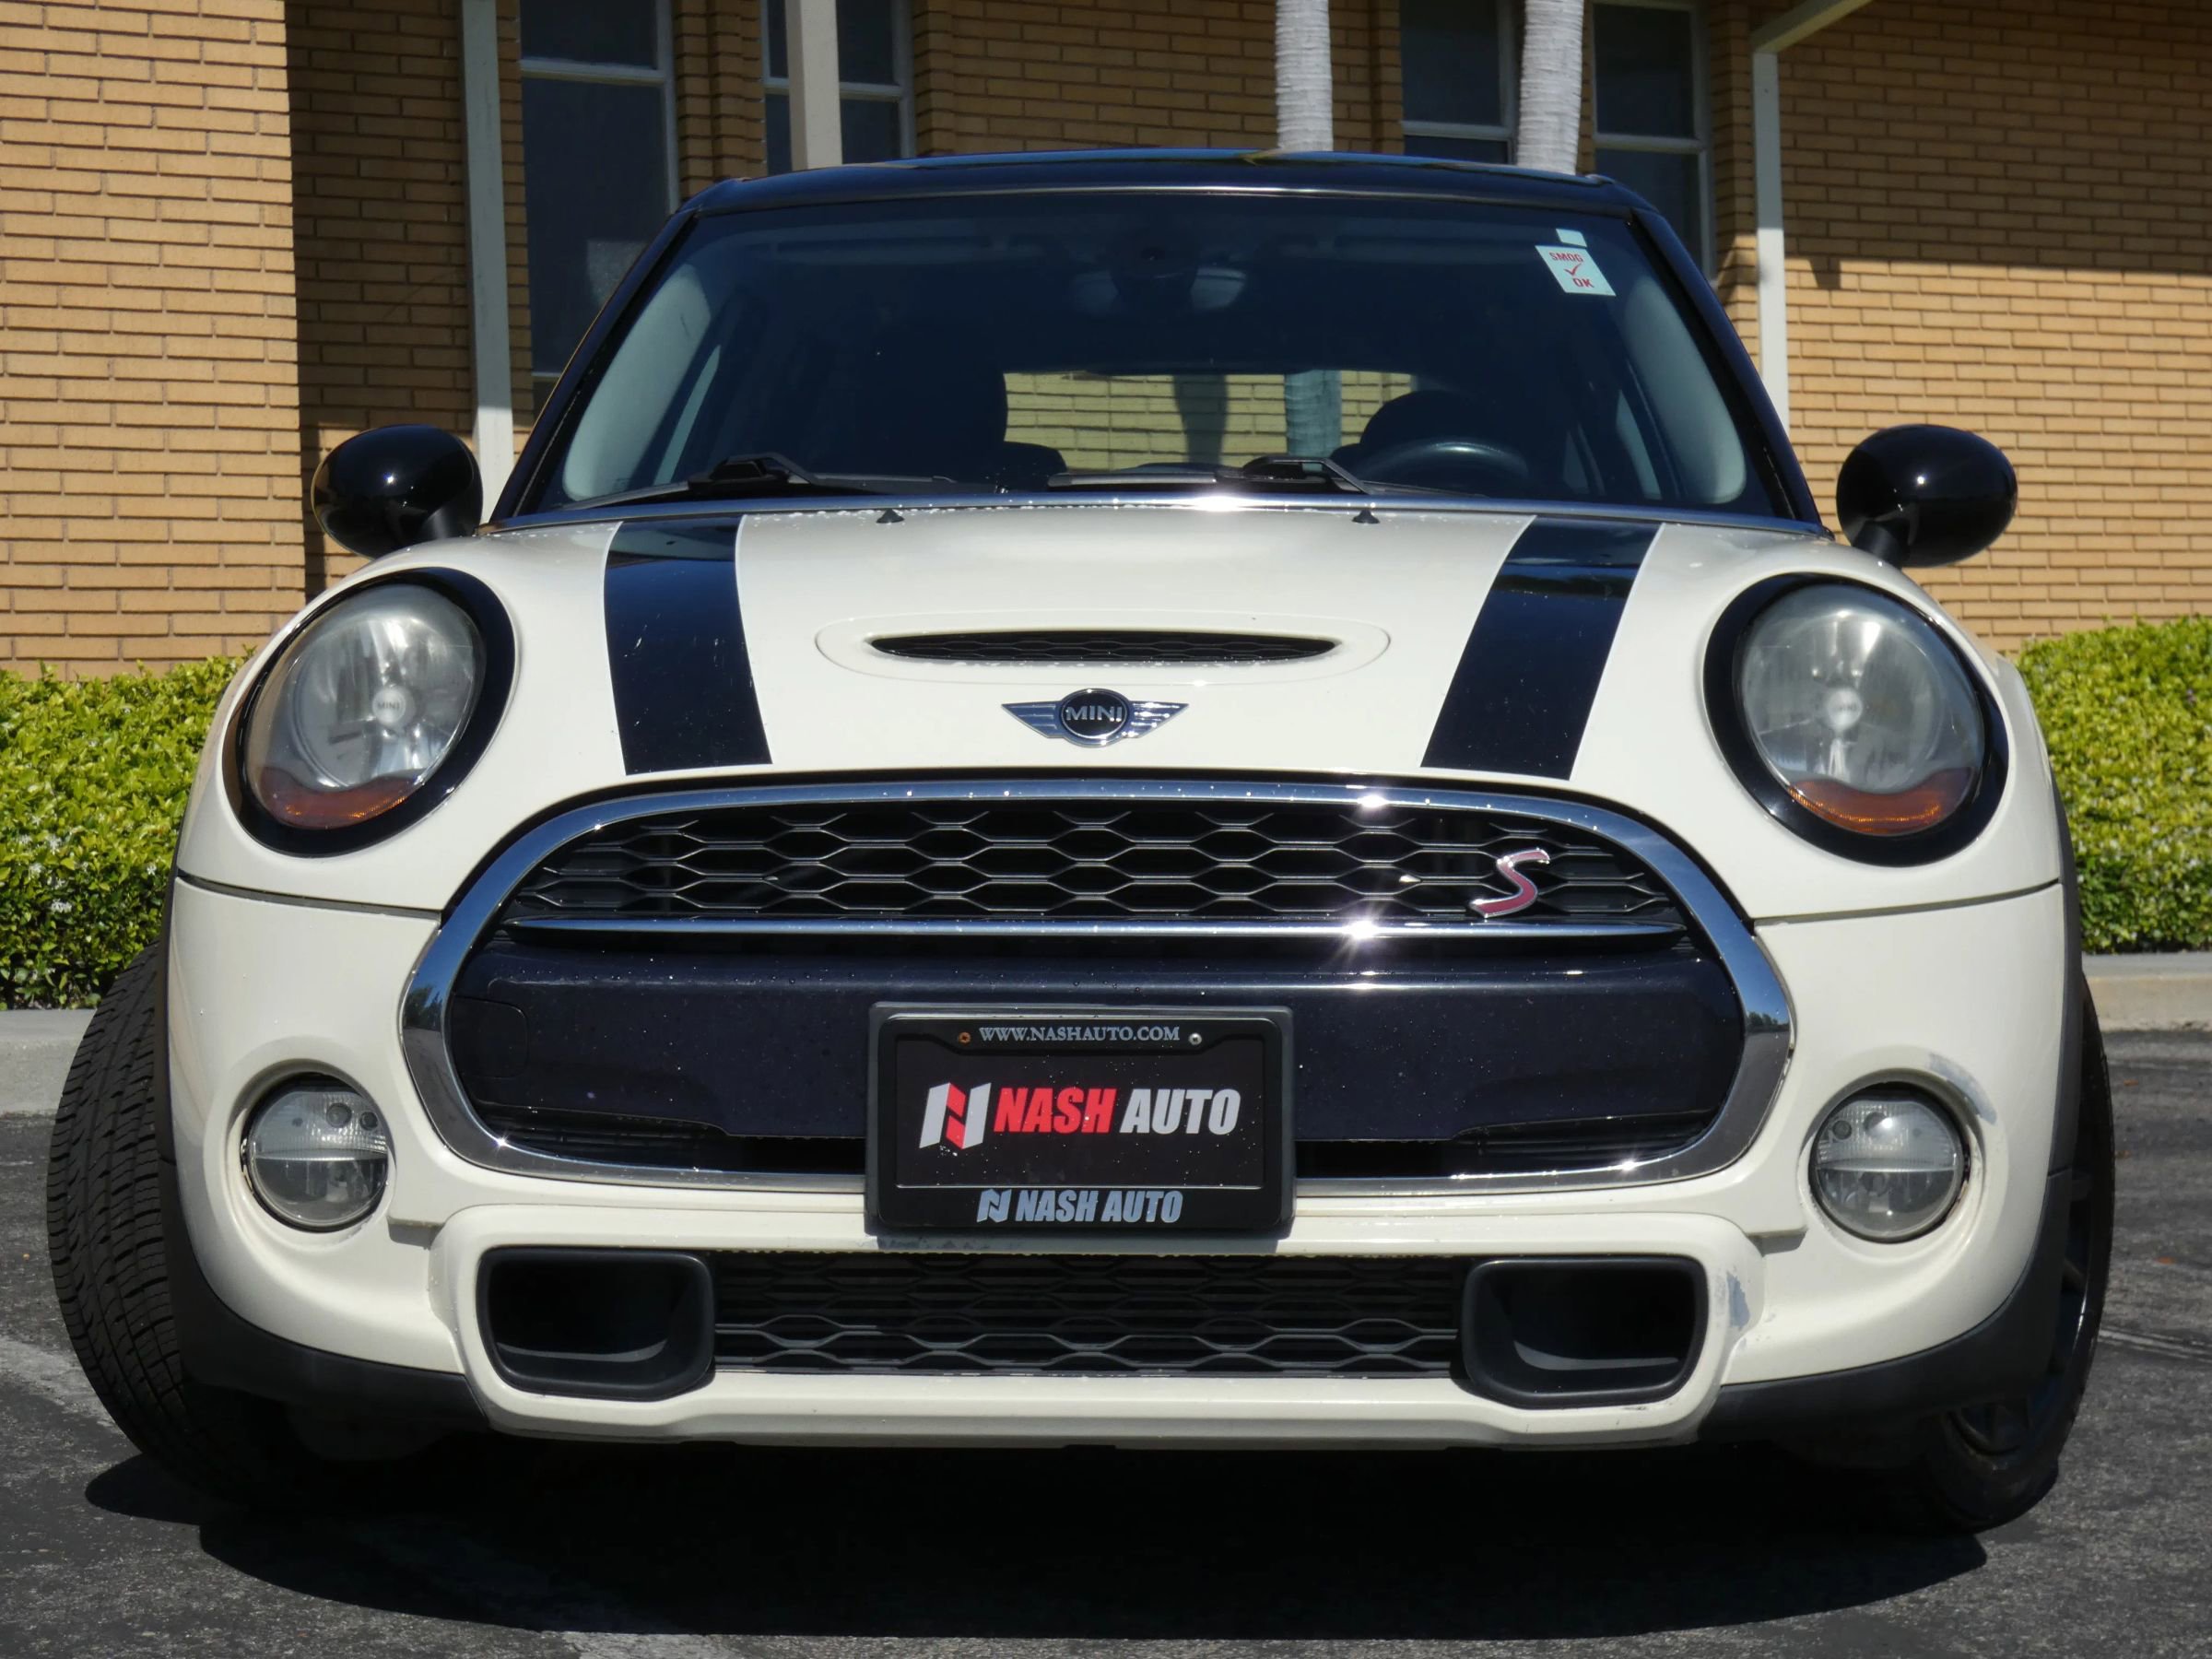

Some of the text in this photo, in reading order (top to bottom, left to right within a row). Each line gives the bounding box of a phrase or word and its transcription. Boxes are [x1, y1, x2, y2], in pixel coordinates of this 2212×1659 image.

[1548, 252, 1583, 263] SMOG
[1572, 277, 1594, 288] OK
[1065, 705, 1123, 722] MINI
[1469, 847, 1550, 918] S
[979, 1026, 1180, 1041] WWW.NASHAUTO.COM
[994, 1088, 1118, 1134] NASH
[1119, 1088, 1241, 1135] AUTO
[1015, 1190, 1099, 1222] NASH
[1101, 1190, 1183, 1223] AUTO
